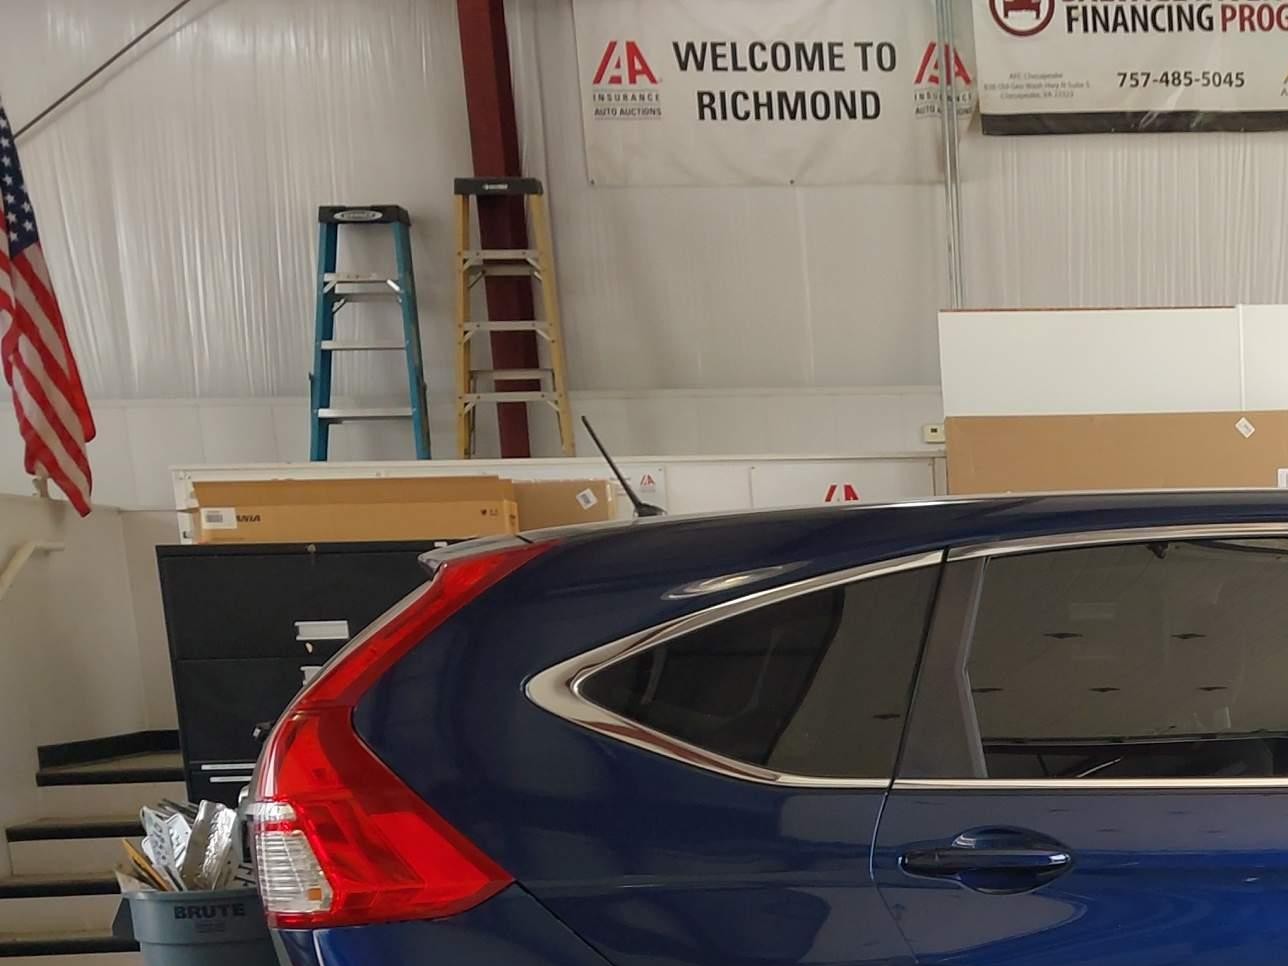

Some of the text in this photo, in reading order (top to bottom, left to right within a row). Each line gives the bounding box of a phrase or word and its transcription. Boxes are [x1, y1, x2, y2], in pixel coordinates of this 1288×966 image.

[1066, 4, 1214, 33] FINANCING
[672, 41, 897, 72] WELCOME TO
[1117, 71, 1246, 88] 757-485-5045
[593, 93, 659, 102] INSURANCE
[697, 91, 881, 121] RICHMOND
[595, 107, 662, 117] AUTO AUCTIONS
[174, 903, 246, 920] BRUTE
